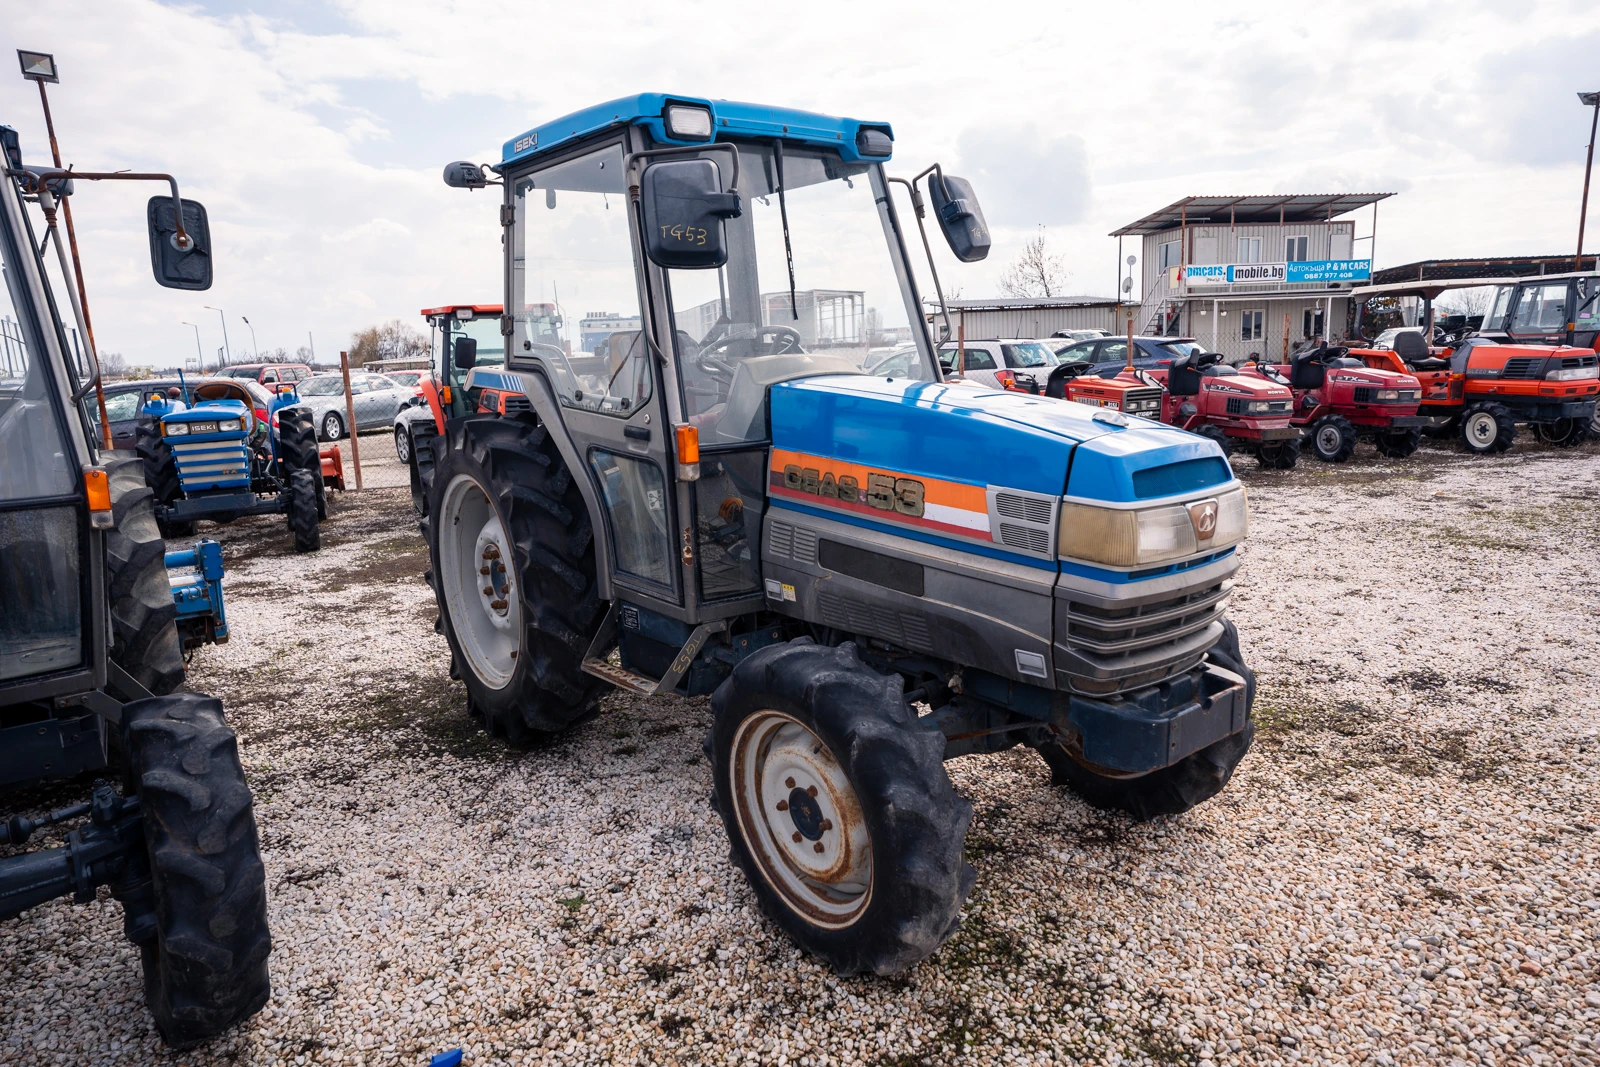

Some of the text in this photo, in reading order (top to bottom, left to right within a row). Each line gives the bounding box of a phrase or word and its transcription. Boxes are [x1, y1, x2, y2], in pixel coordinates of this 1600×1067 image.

[514, 132, 538, 154] ISEKI
[660, 224, 707, 246] TG53
[1235, 266, 1284, 279] mobile.bg
[1332, 262, 1339, 270] &
[1340, 262, 1347, 270] M
[1348, 261, 1369, 270] CARS
[867, 471, 925, 518] 53
